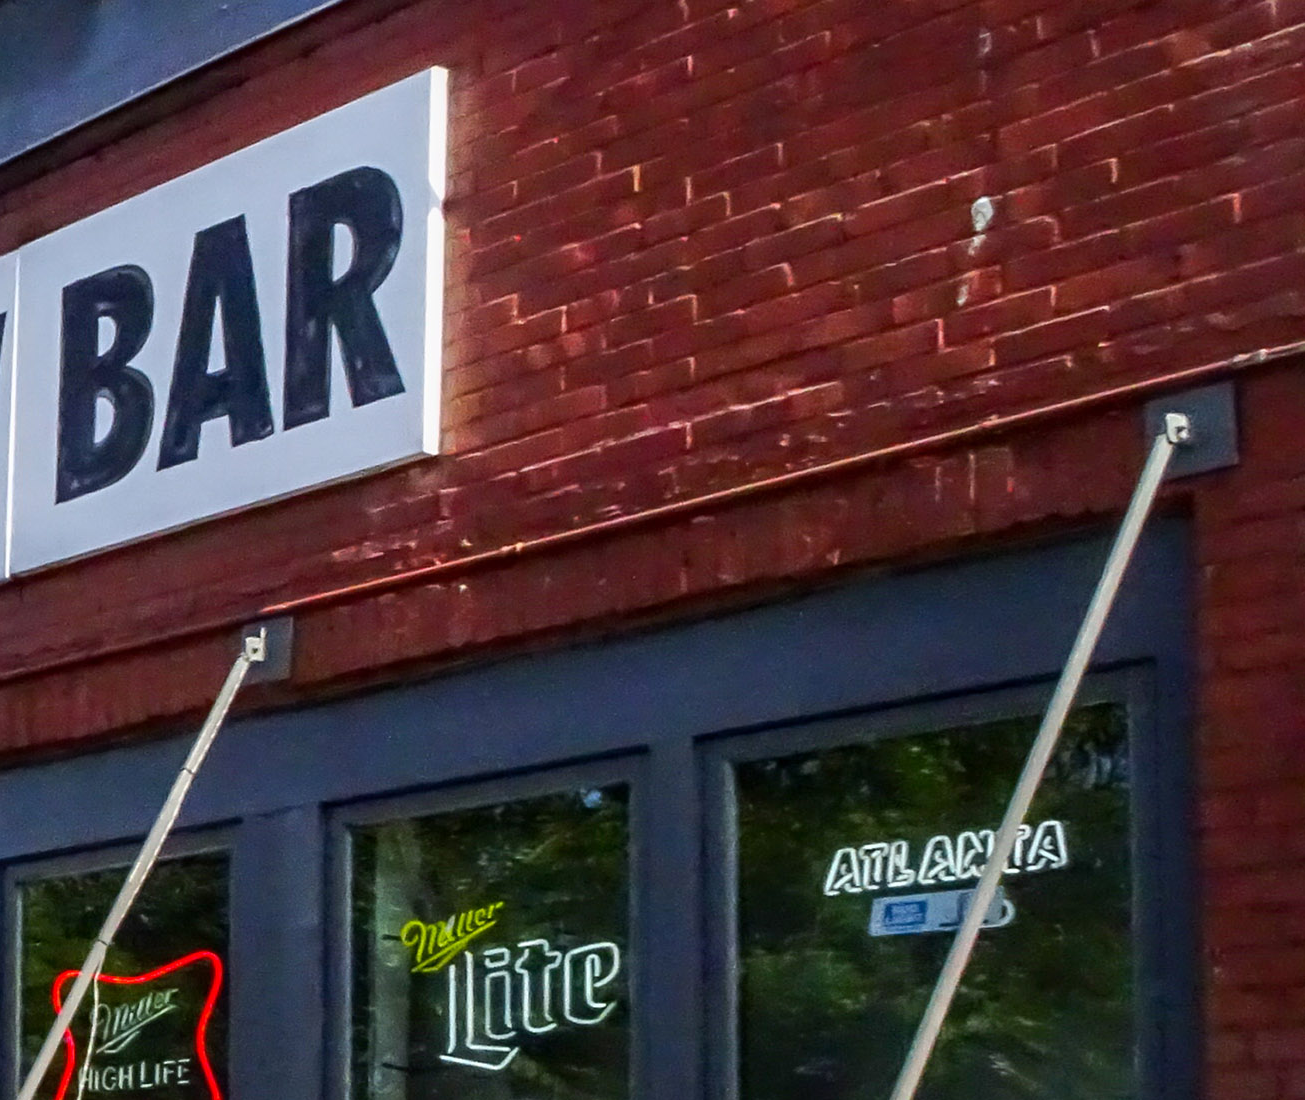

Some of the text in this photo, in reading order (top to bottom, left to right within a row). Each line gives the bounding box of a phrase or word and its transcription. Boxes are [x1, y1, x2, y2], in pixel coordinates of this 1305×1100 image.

[55, 165, 406, 504] BAR
[823, 820, 1069, 896] ATLANTA
[400, 902, 505, 966] Miller
[89, 988, 179, 1044] Miller
[438, 938, 620, 1070] Lite
[77, 1058, 190, 1092] HIGH LIFE
